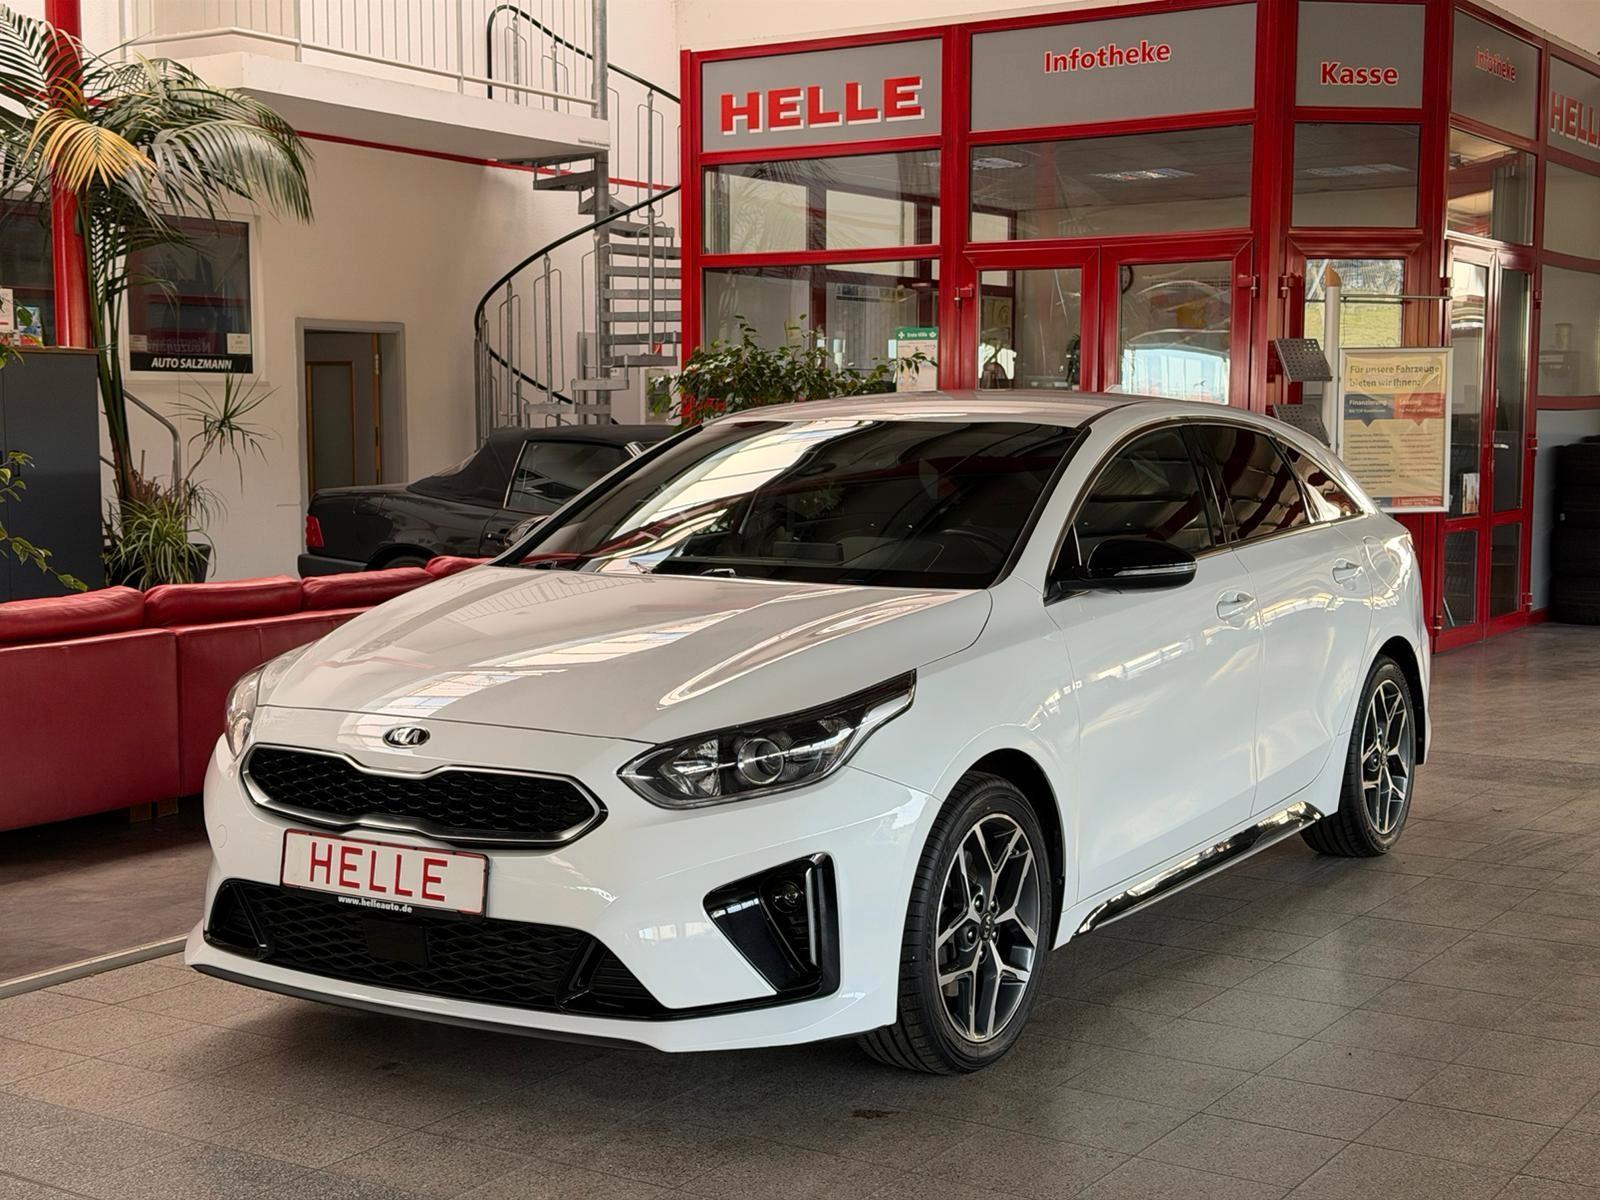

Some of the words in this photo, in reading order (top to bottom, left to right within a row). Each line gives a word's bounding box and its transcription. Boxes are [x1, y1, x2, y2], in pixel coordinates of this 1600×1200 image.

[1044, 40, 1171, 73] Infotheke
[1321, 62, 1399, 86] Kasse
[721, 76, 924, 135] HELLE
[1550, 91, 1600, 149] HELL
[151, 357, 179, 368] AUTO
[180, 358, 232, 369] SALZMANN
[309, 842, 448, 902] HELLE
[338, 895, 413, 913] www.helleauto.de
